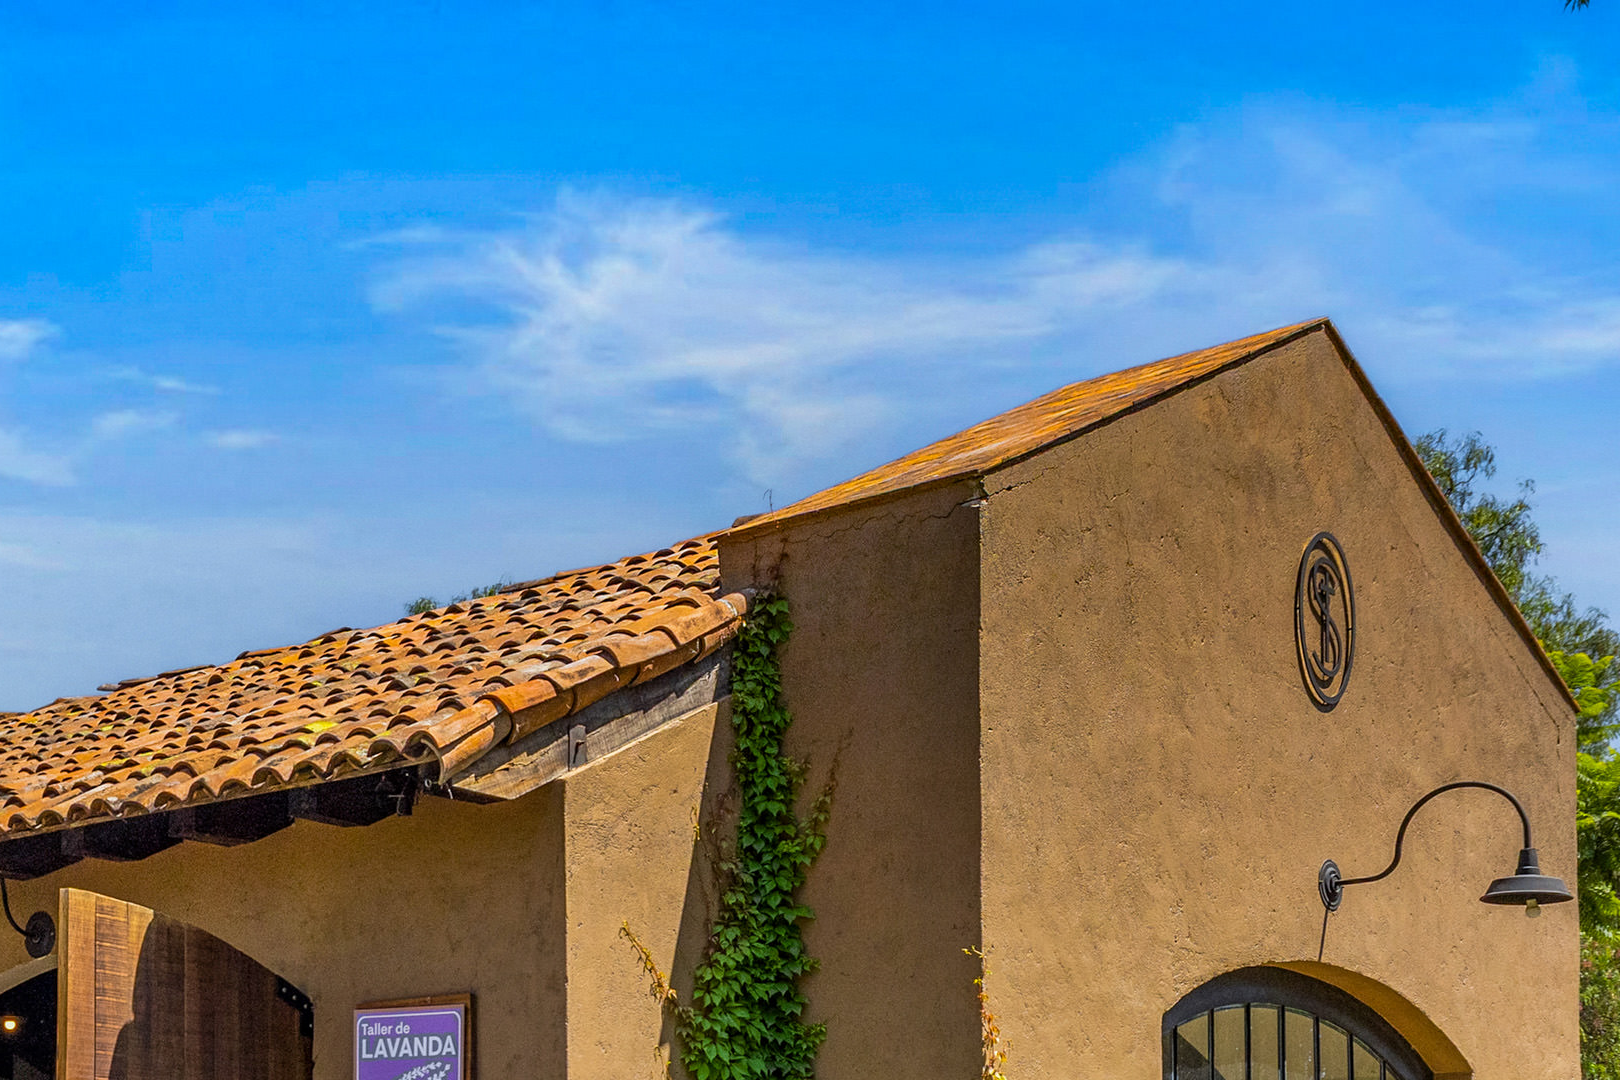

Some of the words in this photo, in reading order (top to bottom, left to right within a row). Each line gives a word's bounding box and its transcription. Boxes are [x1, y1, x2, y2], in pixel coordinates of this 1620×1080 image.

[361, 1022, 393, 1036] Taller
[395, 1021, 411, 1034] de
[361, 1035, 456, 1059] LAVANDA
